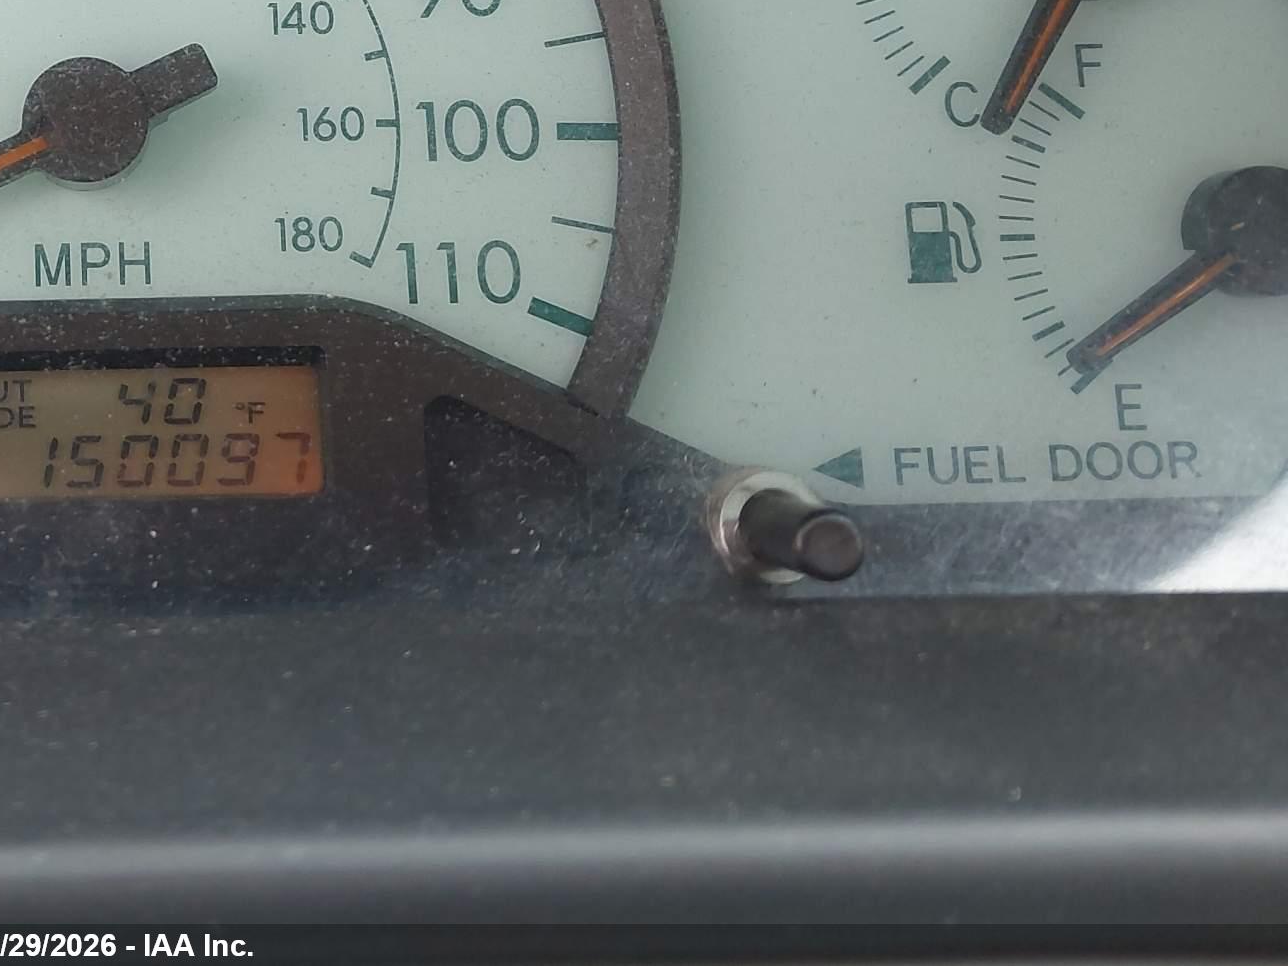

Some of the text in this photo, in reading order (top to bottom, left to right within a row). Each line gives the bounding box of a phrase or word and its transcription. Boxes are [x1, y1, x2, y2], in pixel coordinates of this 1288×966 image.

[267, 1, 334, 35] 140
[1074, 44, 1103, 87] F
[296, 107, 365, 143] 160
[945, 83, 980, 127] C
[415, 98, 540, 162] 100
[274, 216, 344, 252] 180
[34, 241, 152, 287] MPH
[396, 240, 521, 304] 110
[117, 378, 206, 425] 40
[1114, 384, 1148, 431] E
[44, 435, 310, 488] 150097
[893, 441, 1202, 485] FUEL DOOR
